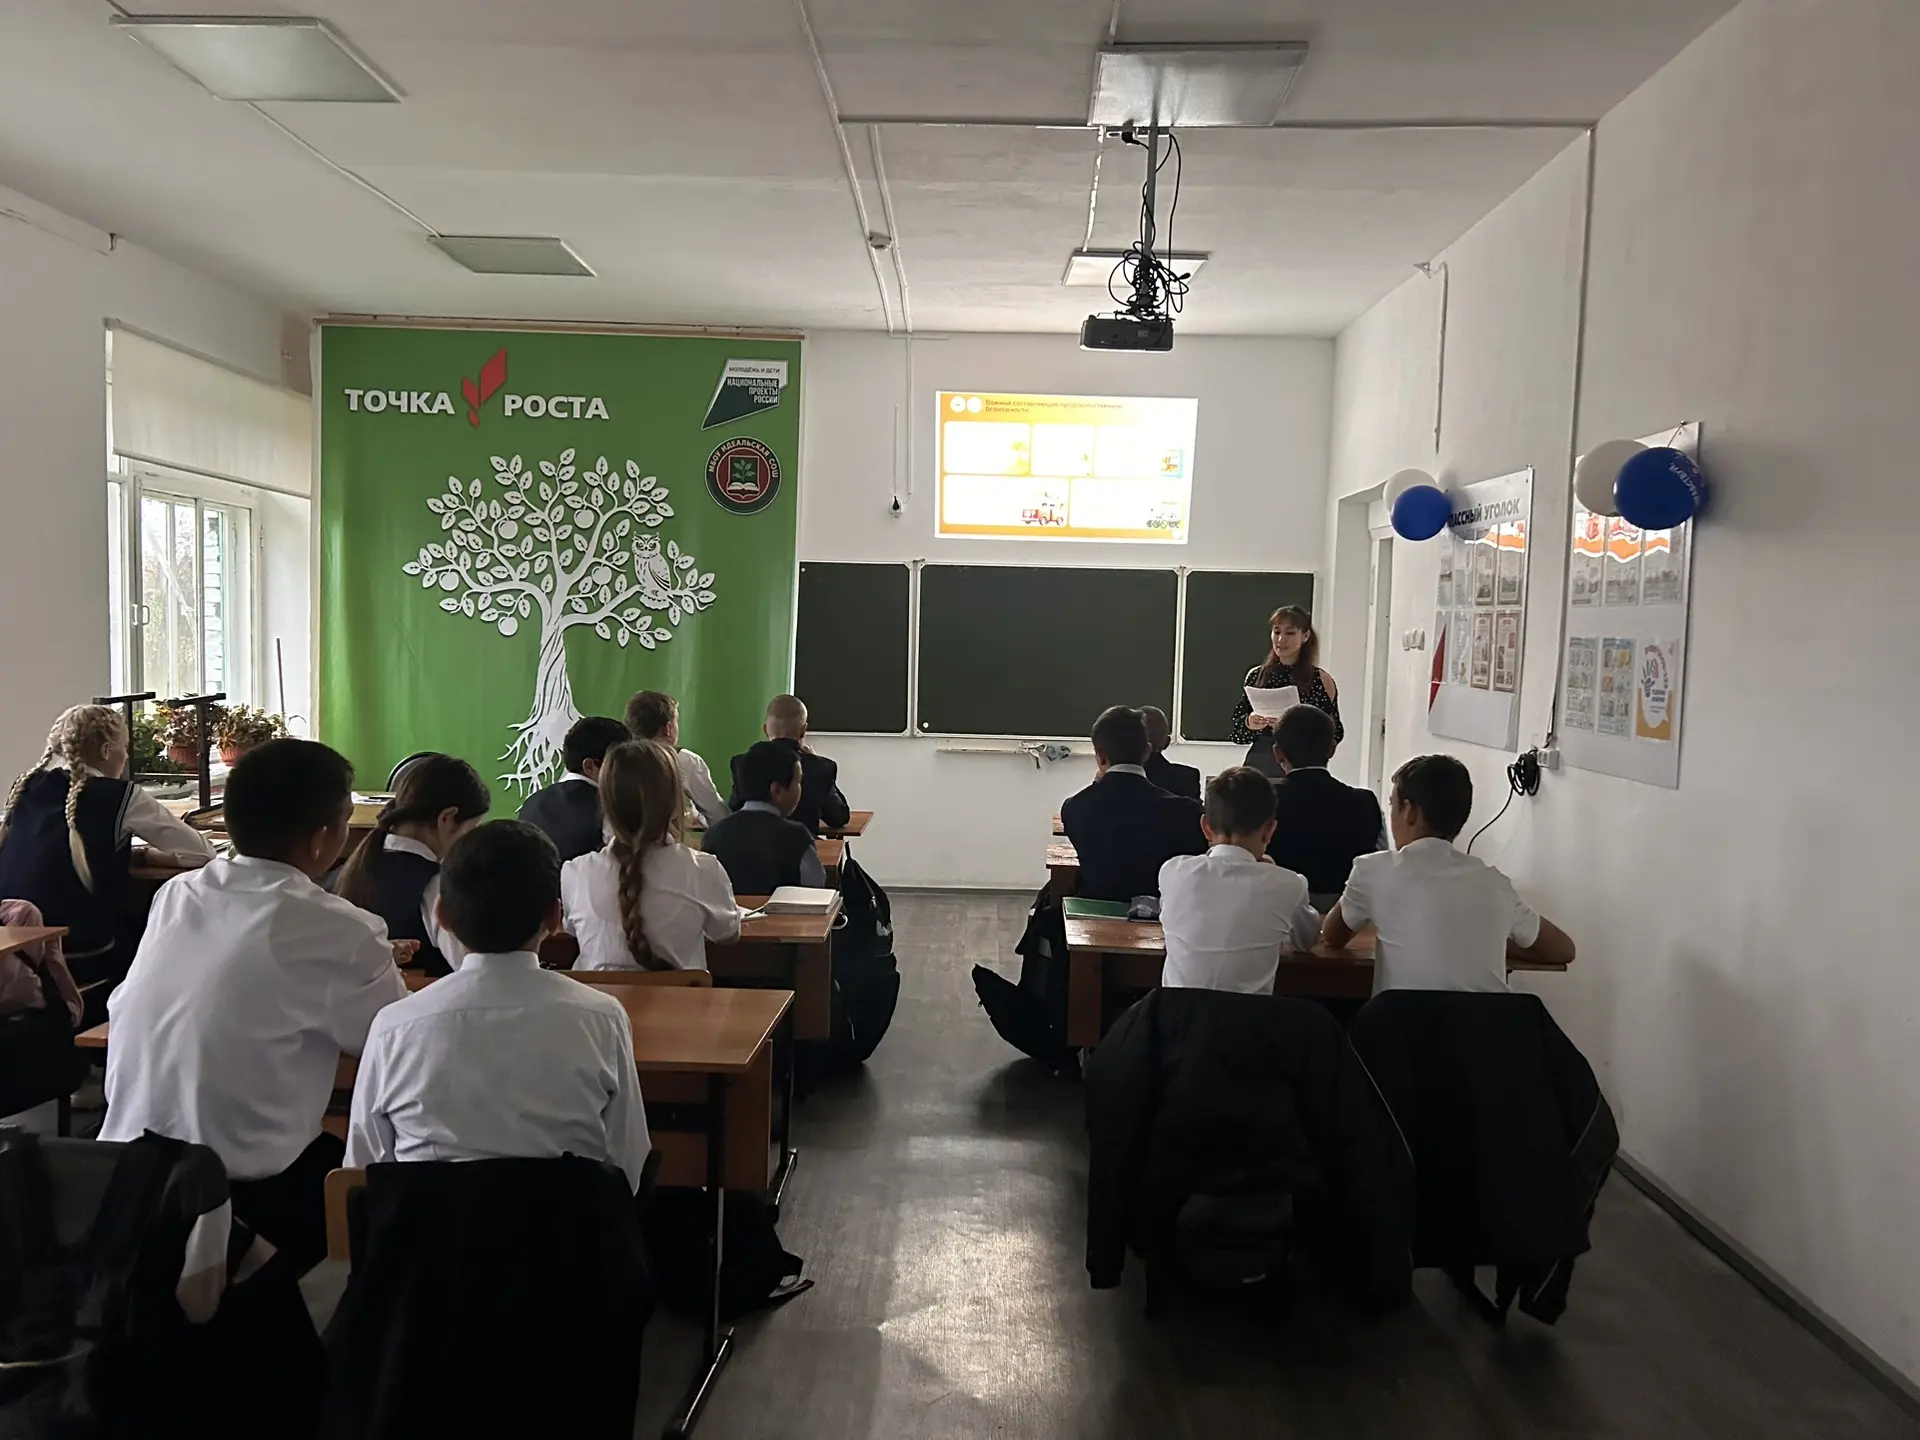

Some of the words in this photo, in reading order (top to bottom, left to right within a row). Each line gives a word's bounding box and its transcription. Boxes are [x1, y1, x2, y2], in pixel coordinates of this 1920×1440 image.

[727, 378, 778, 388] НАЦИОНАЛЬНЫЕ
[748, 386, 778, 395] ПРОЕКТЫ
[344, 388, 455, 414] ТОЧКА
[504, 394, 609, 419] РОСТА
[753, 395, 778, 403] РОССИИ
[708, 451, 722, 473] МБОУ
[720, 439, 770, 457] ИДЕАЛЬСКАЯ
[768, 458, 779, 478] СОШ
[1447, 503, 1482, 528] ЛАССНЫЙ
[1484, 498, 1520, 520] УГОЛОК
